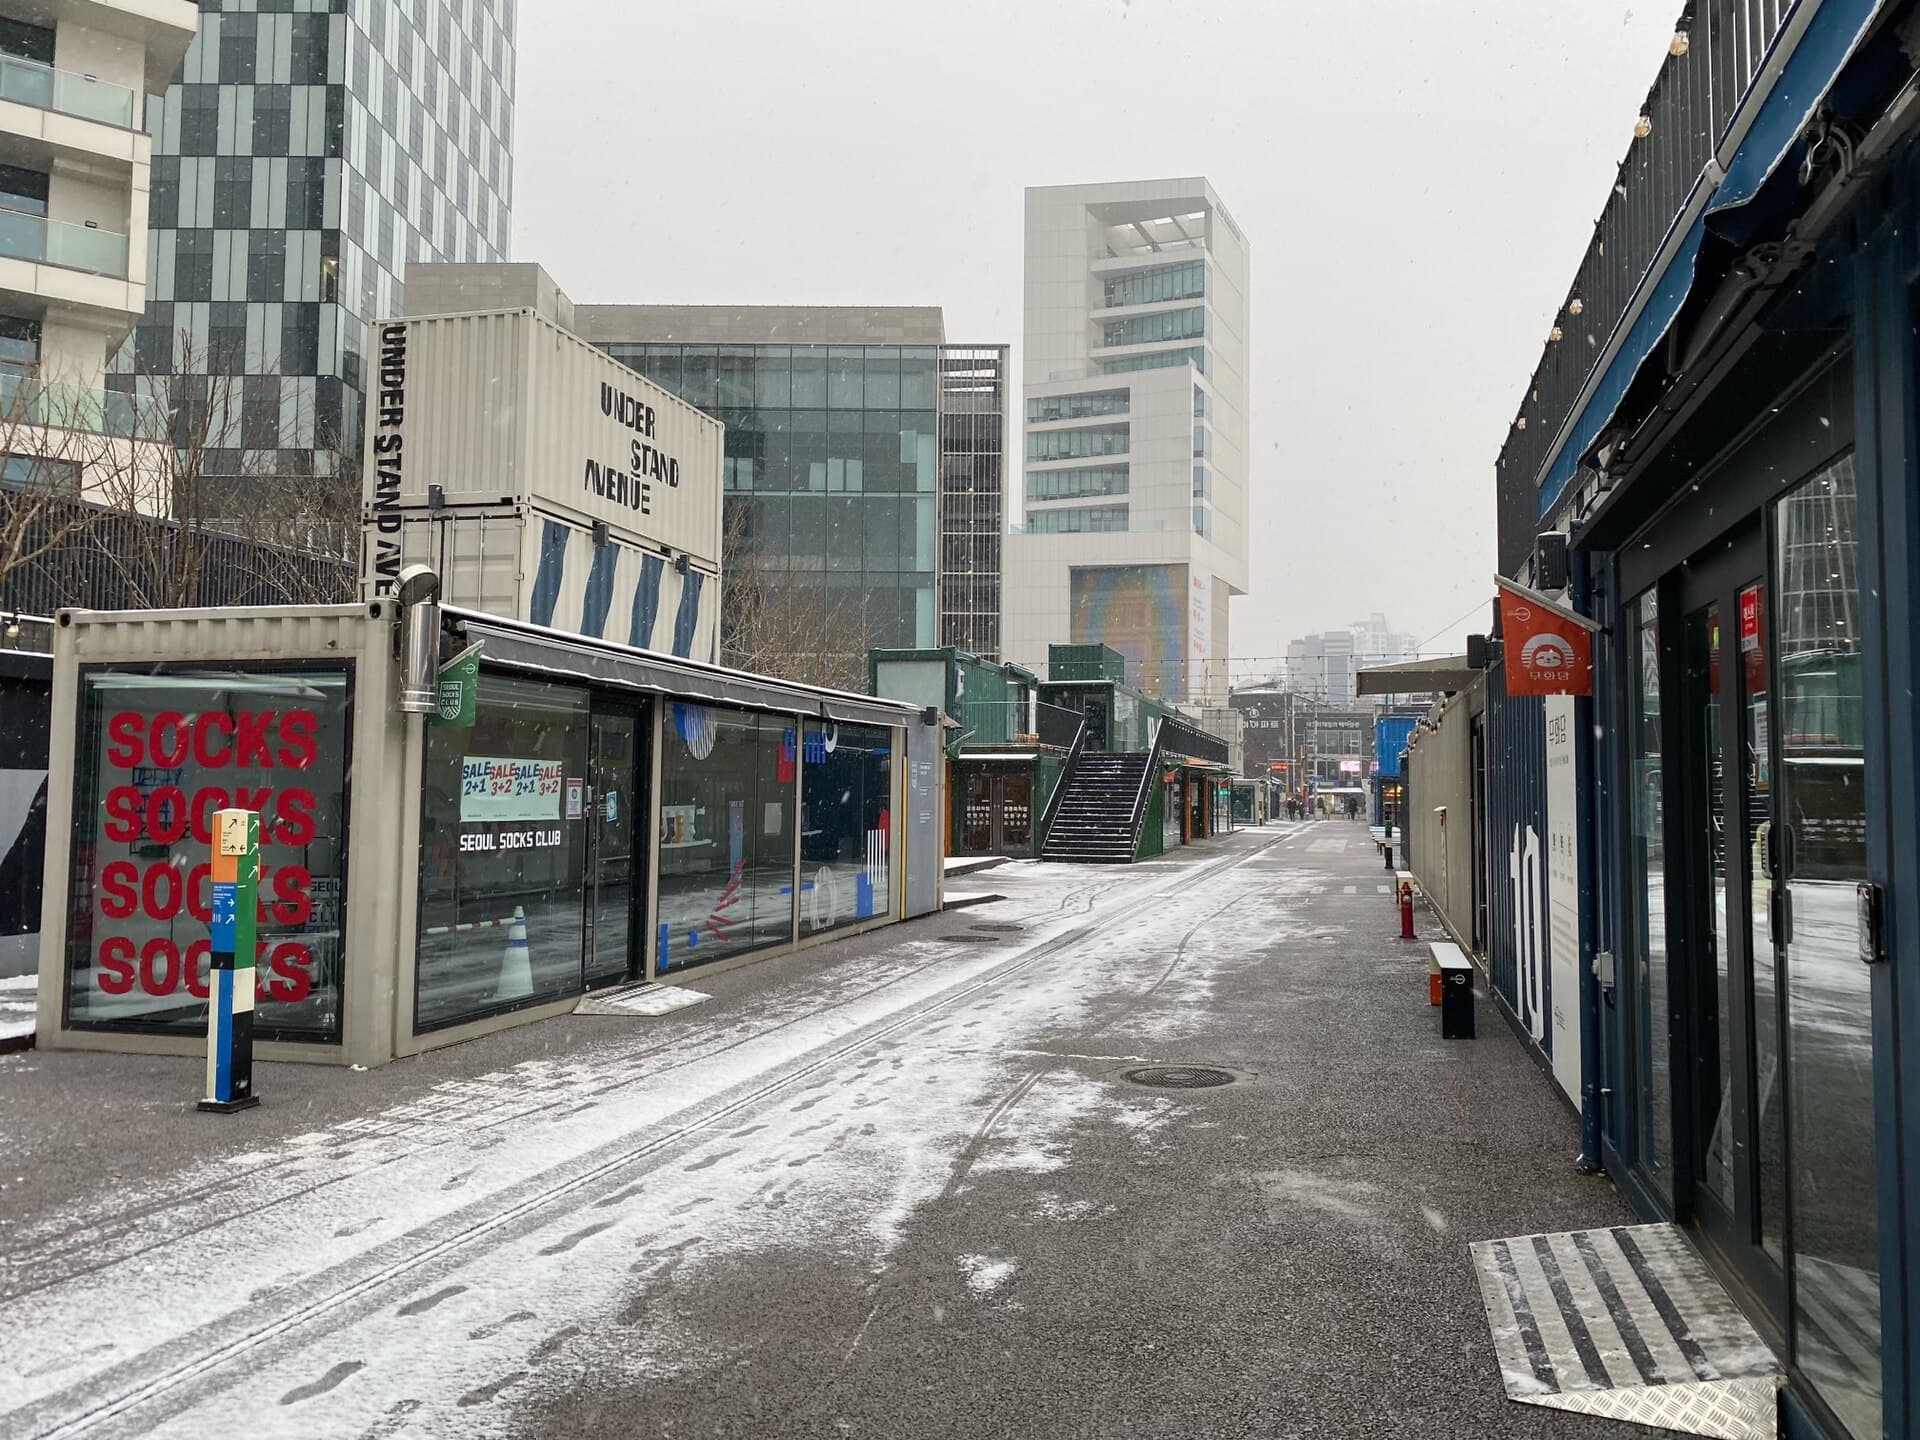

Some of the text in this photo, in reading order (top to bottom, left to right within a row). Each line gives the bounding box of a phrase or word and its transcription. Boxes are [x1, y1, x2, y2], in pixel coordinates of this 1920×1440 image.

[379, 326, 407, 427] UNDER
[600, 381, 655, 440] UNDER
[374, 434, 403, 533] STAND
[584, 458, 651, 515] AVENUE
[631, 439, 679, 488] STAND
[107, 709, 319, 769] SOCKS
[462, 761, 562, 781] SALE SALE SALE SALE
[464, 779, 559, 796] 2+1 3+2 2+1 3+2
[460, 830, 560, 851] SEOUL SOCKS CLUB
